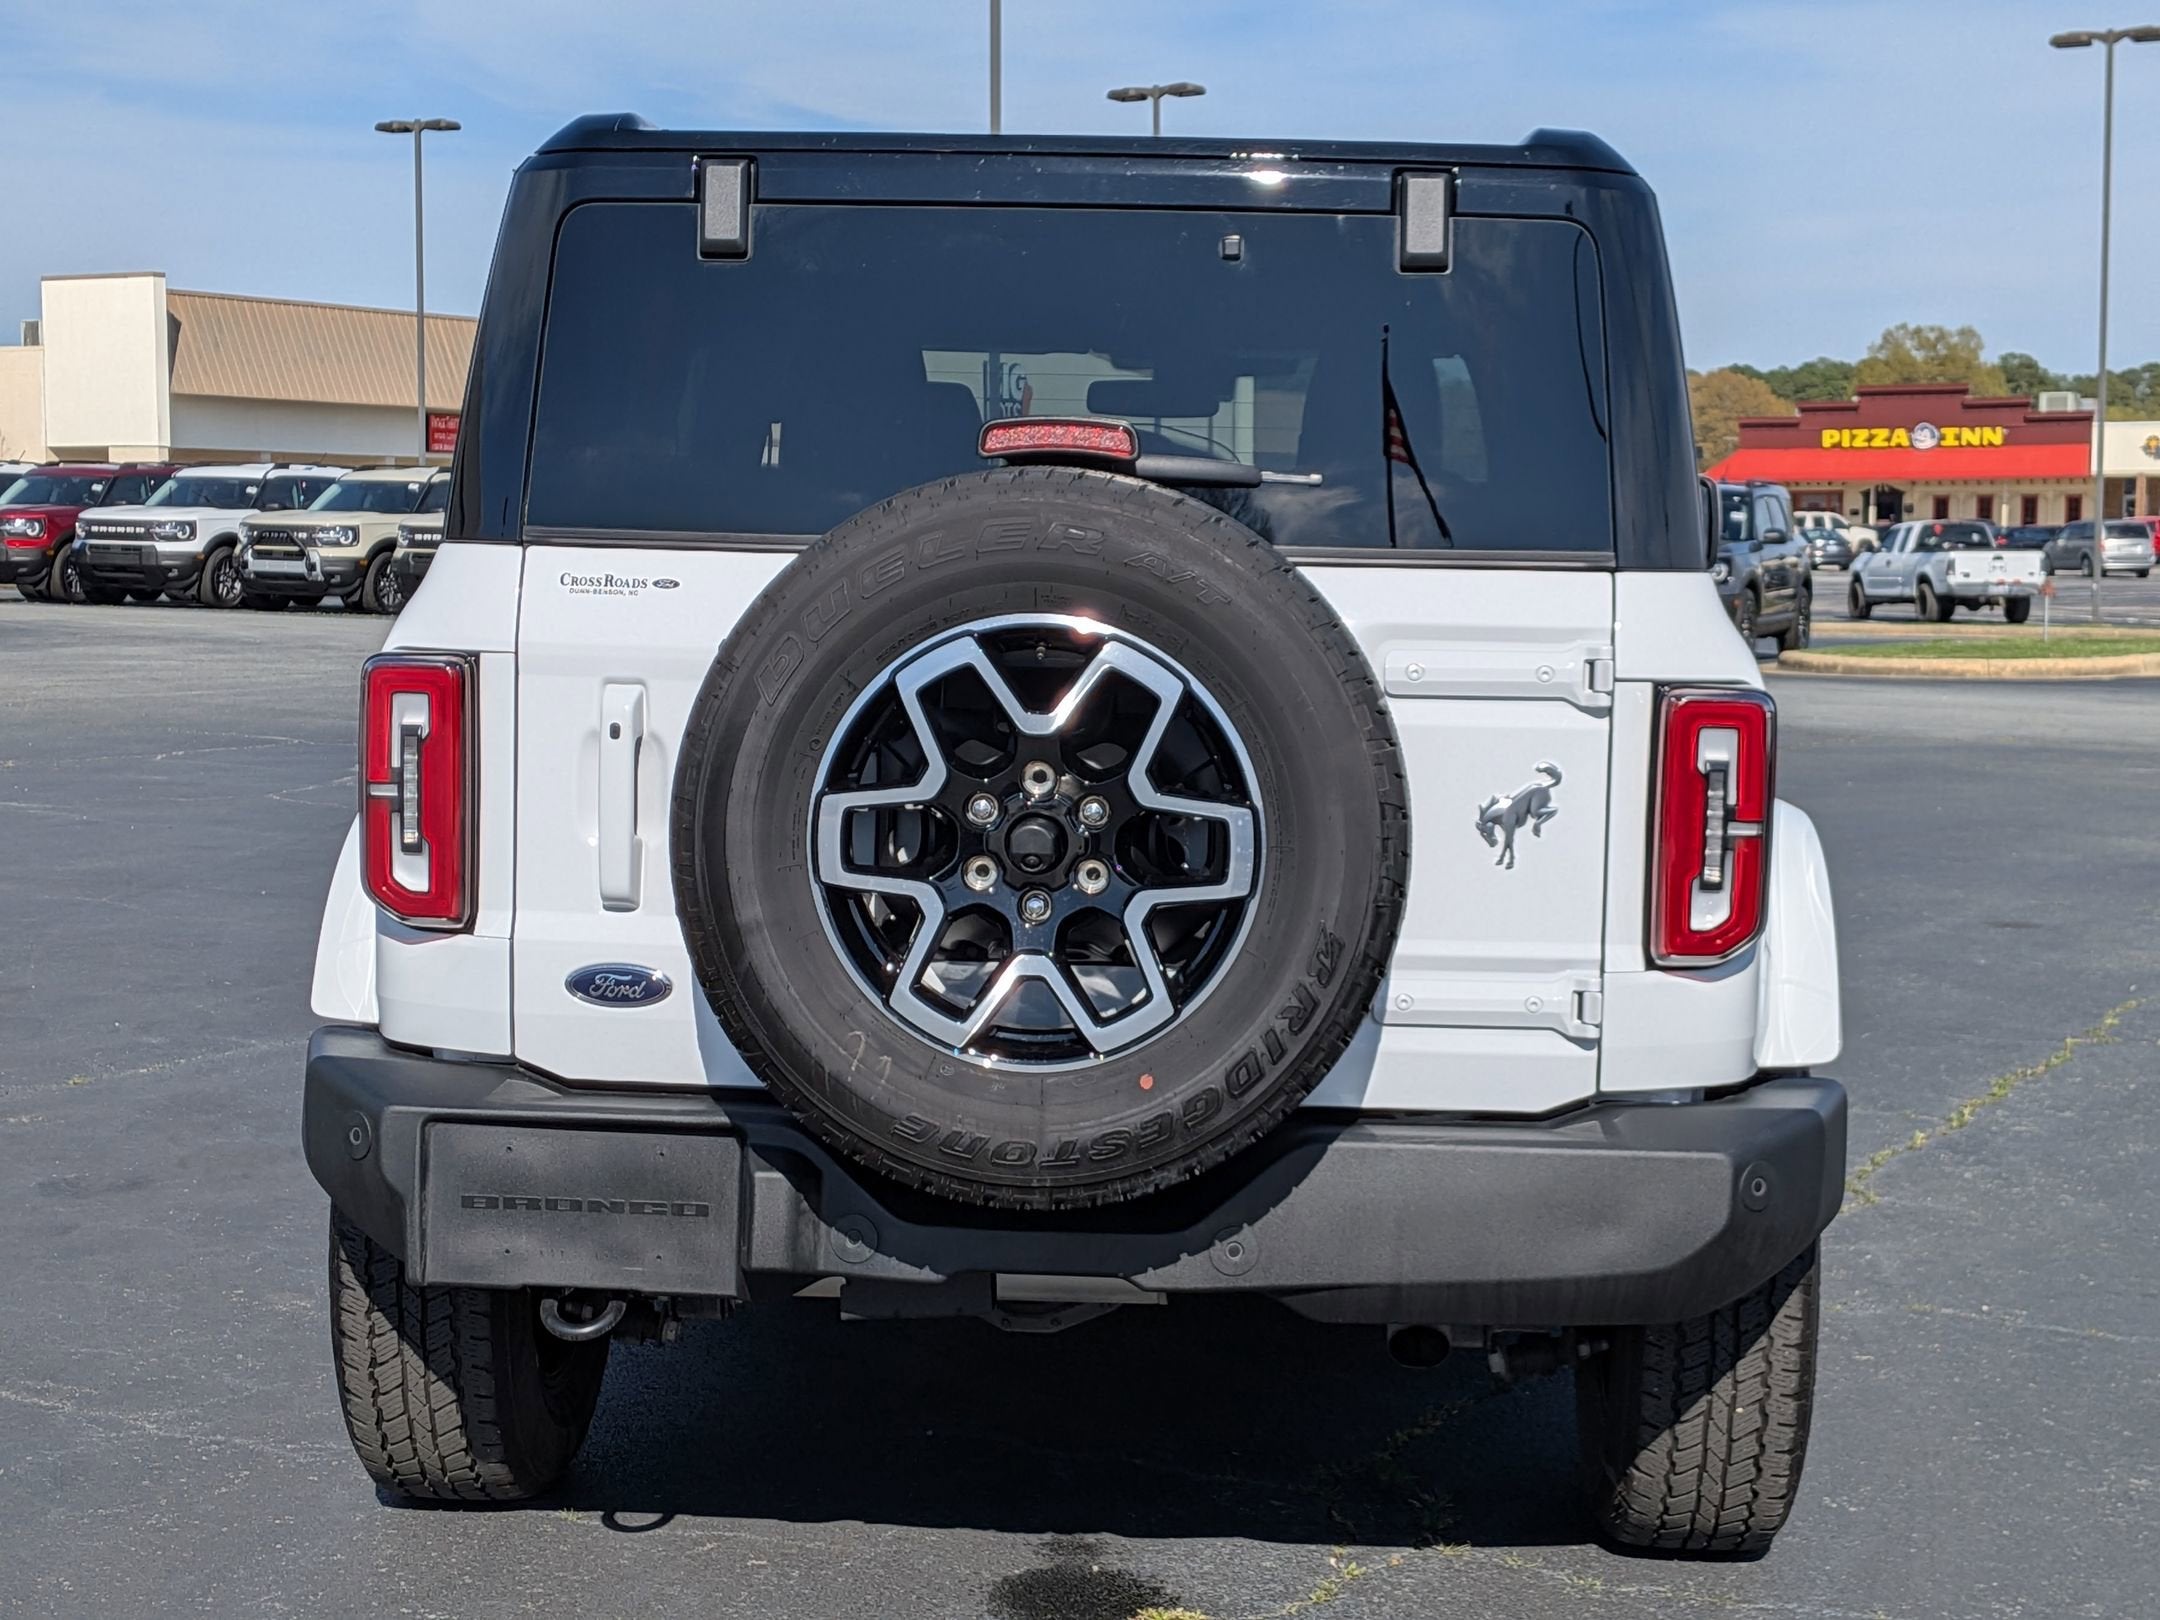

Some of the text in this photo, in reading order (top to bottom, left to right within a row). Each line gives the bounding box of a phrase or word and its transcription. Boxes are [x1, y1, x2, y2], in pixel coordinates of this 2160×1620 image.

[1821, 426, 2003, 448] PIZZA INN
[754, 519, 1104, 706] DUELER
[1122, 550, 1235, 606] A/T
[589, 974, 647, 998] Ford
[893, 920, 1346, 1170] BRIDGESTONE
[461, 1194, 715, 1217] BRONCO
